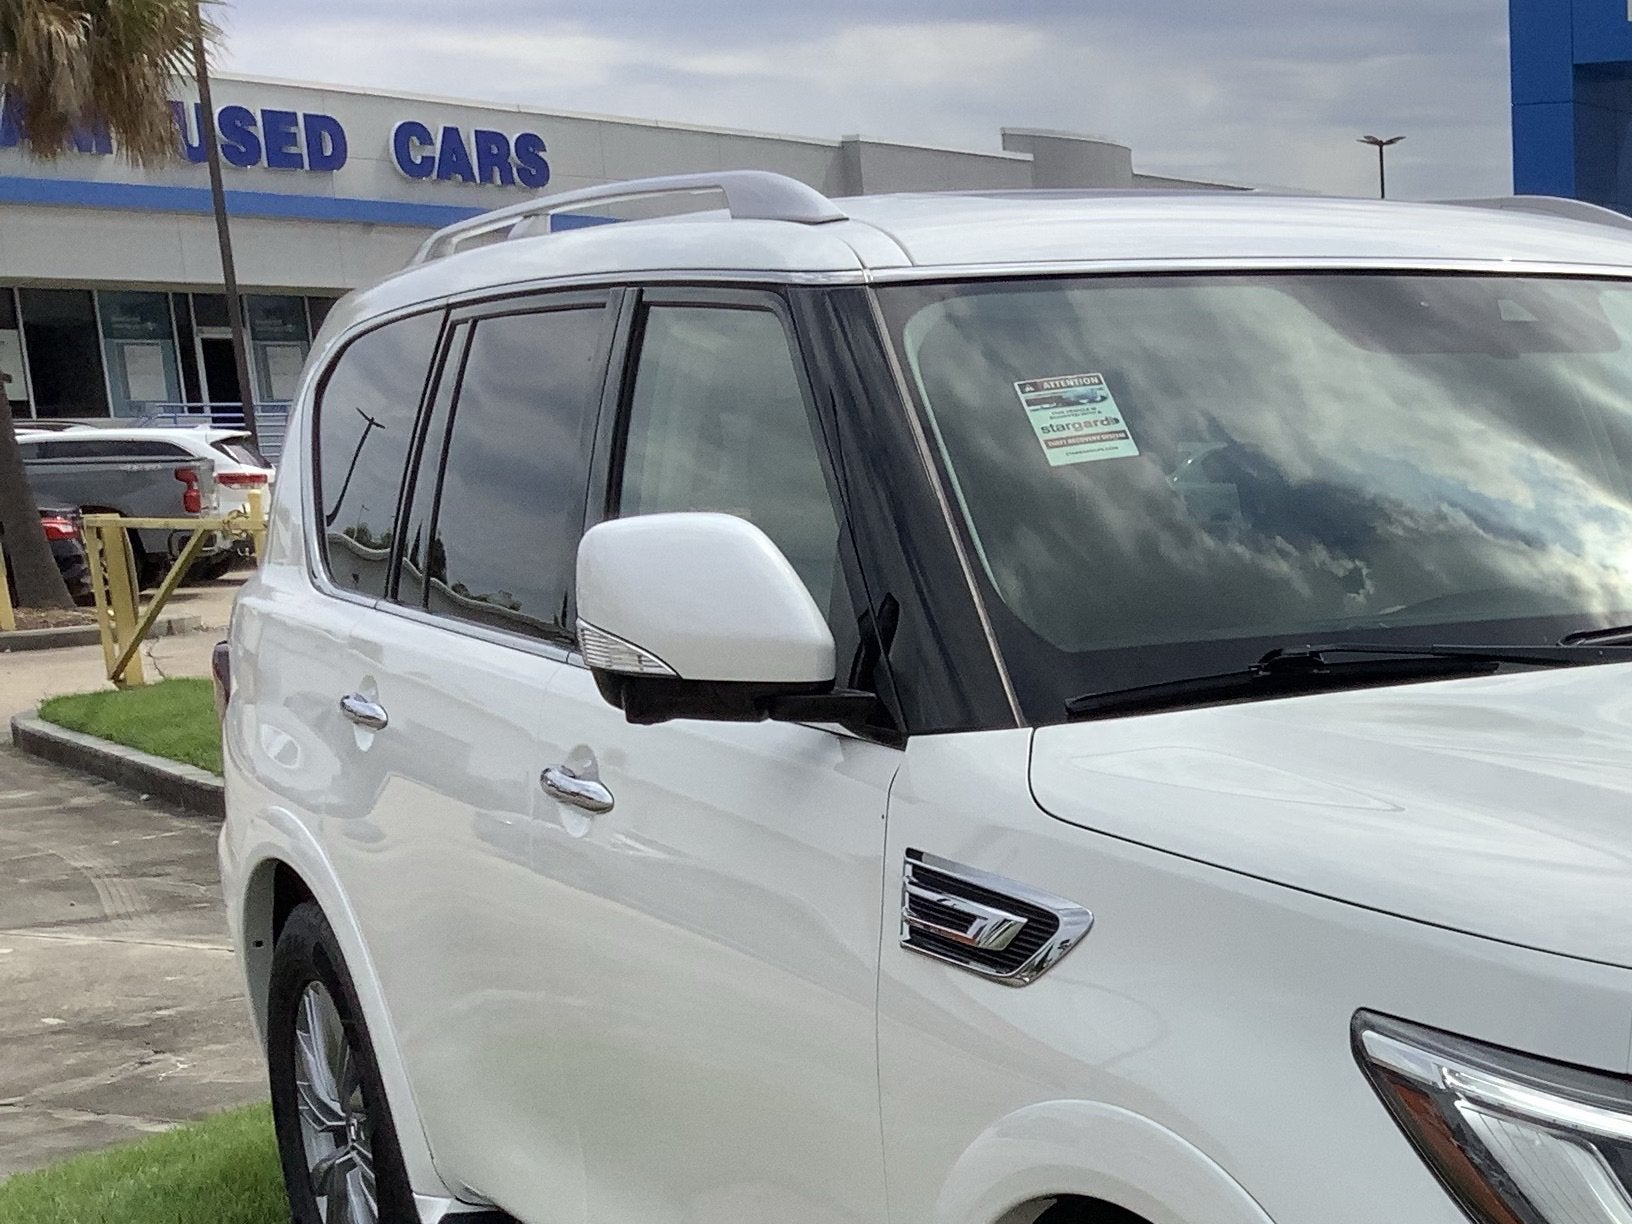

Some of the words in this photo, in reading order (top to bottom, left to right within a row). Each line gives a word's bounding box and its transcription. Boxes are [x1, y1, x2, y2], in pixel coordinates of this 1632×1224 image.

[170, 99, 348, 172] USED
[393, 120, 550, 188] CARS
[1043, 377, 1099, 389] ATTENTION
